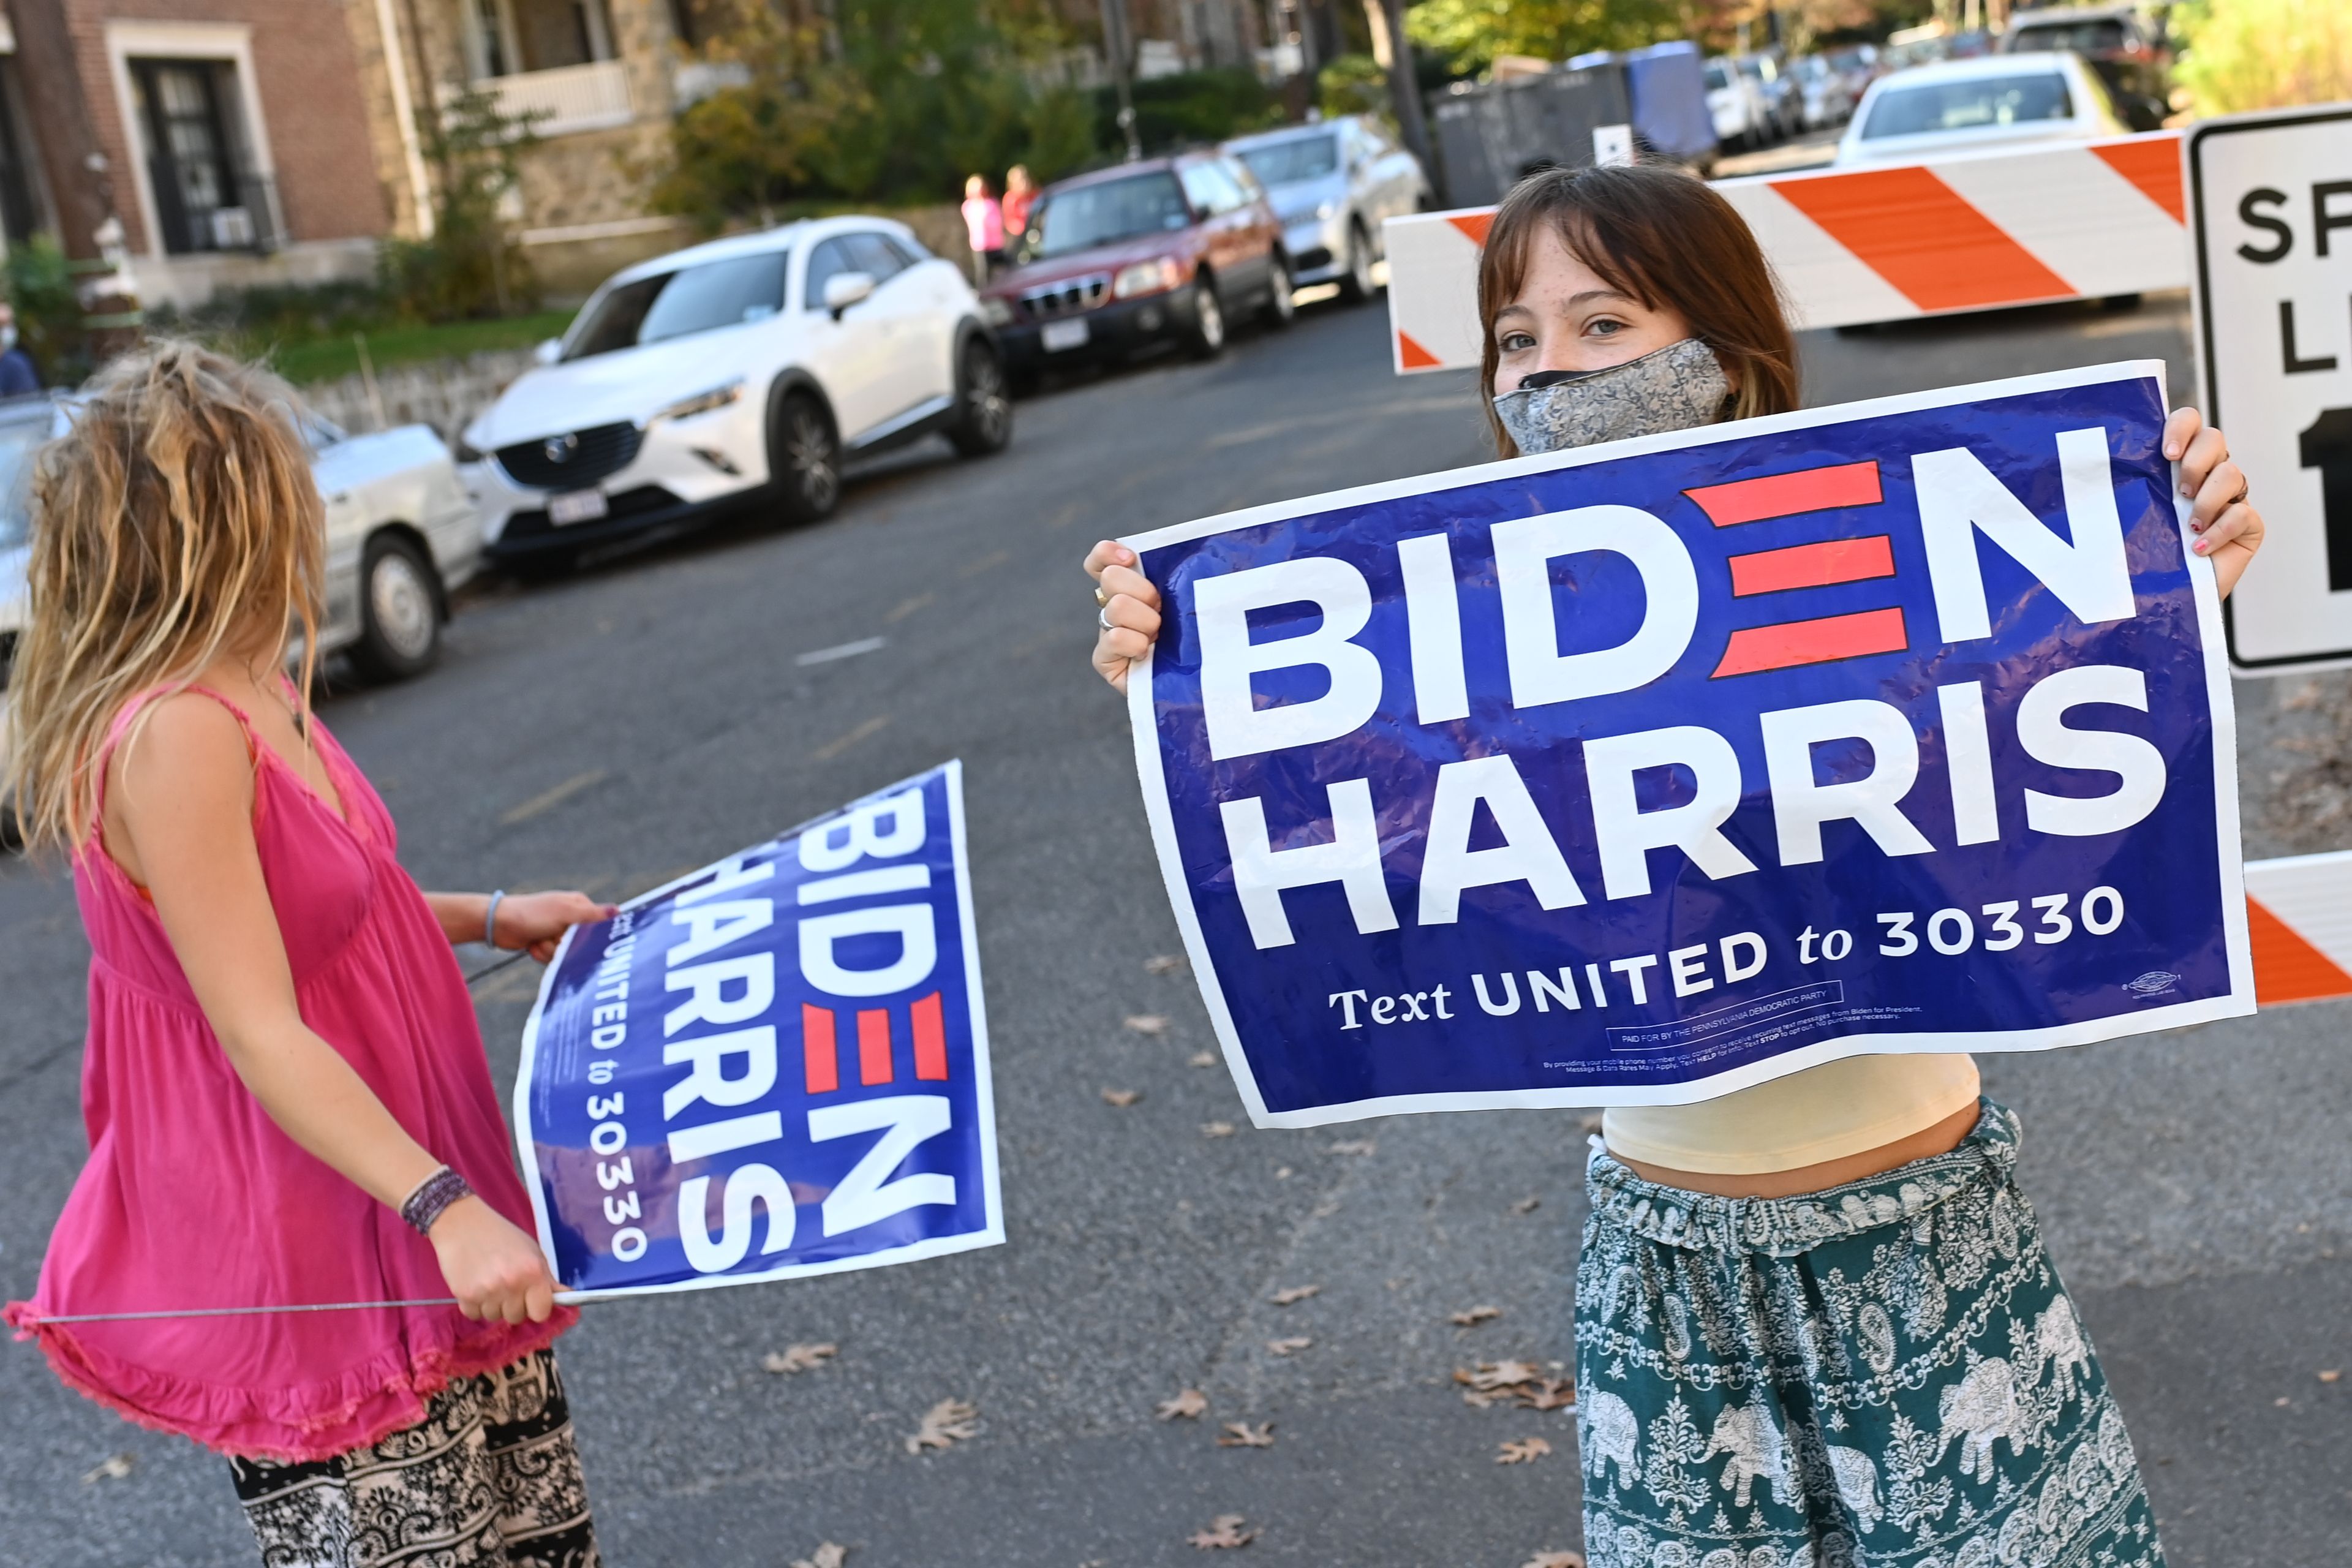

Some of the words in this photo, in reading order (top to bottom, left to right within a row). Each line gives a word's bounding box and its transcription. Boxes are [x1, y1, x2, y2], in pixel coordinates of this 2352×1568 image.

[1191, 427, 2136, 760] BIDEN
[1219, 666, 2166, 949] HARRIS
[591, 935, 636, 1050] UNITED
[797, 788, 957, 1238] BIDEN
[1329, 982, 1453, 1031] Text
[1471, 932, 1767, 1017] UNITED
[1796, 924, 1853, 965] to
[1877, 886, 2125, 957] 30330
[1660, 1031, 1672, 1040] BY
[1673, 1028, 1691, 1038] THE
[1692, 1011, 1749, 1034] PENNSYLVANIA
[1749, 996, 1800, 1017] DEMOCRATIC
[1801, 990, 1827, 1002] PARTY
[587, 1059, 620, 1085] to
[663, 842, 796, 1274] HARRIS
[1692, 1046, 1719, 1057] consent
[1728, 1036, 1752, 1046] receive
[1752, 1026, 1782, 1039] recurring
[1796, 1013, 1830, 1026] messages
[1697, 1052, 1716, 1063] HELP
[1760, 1033, 1779, 1044] STOP
[1827, 1016, 1861, 1025] purchase
[586, 1092, 648, 1262] 30330
